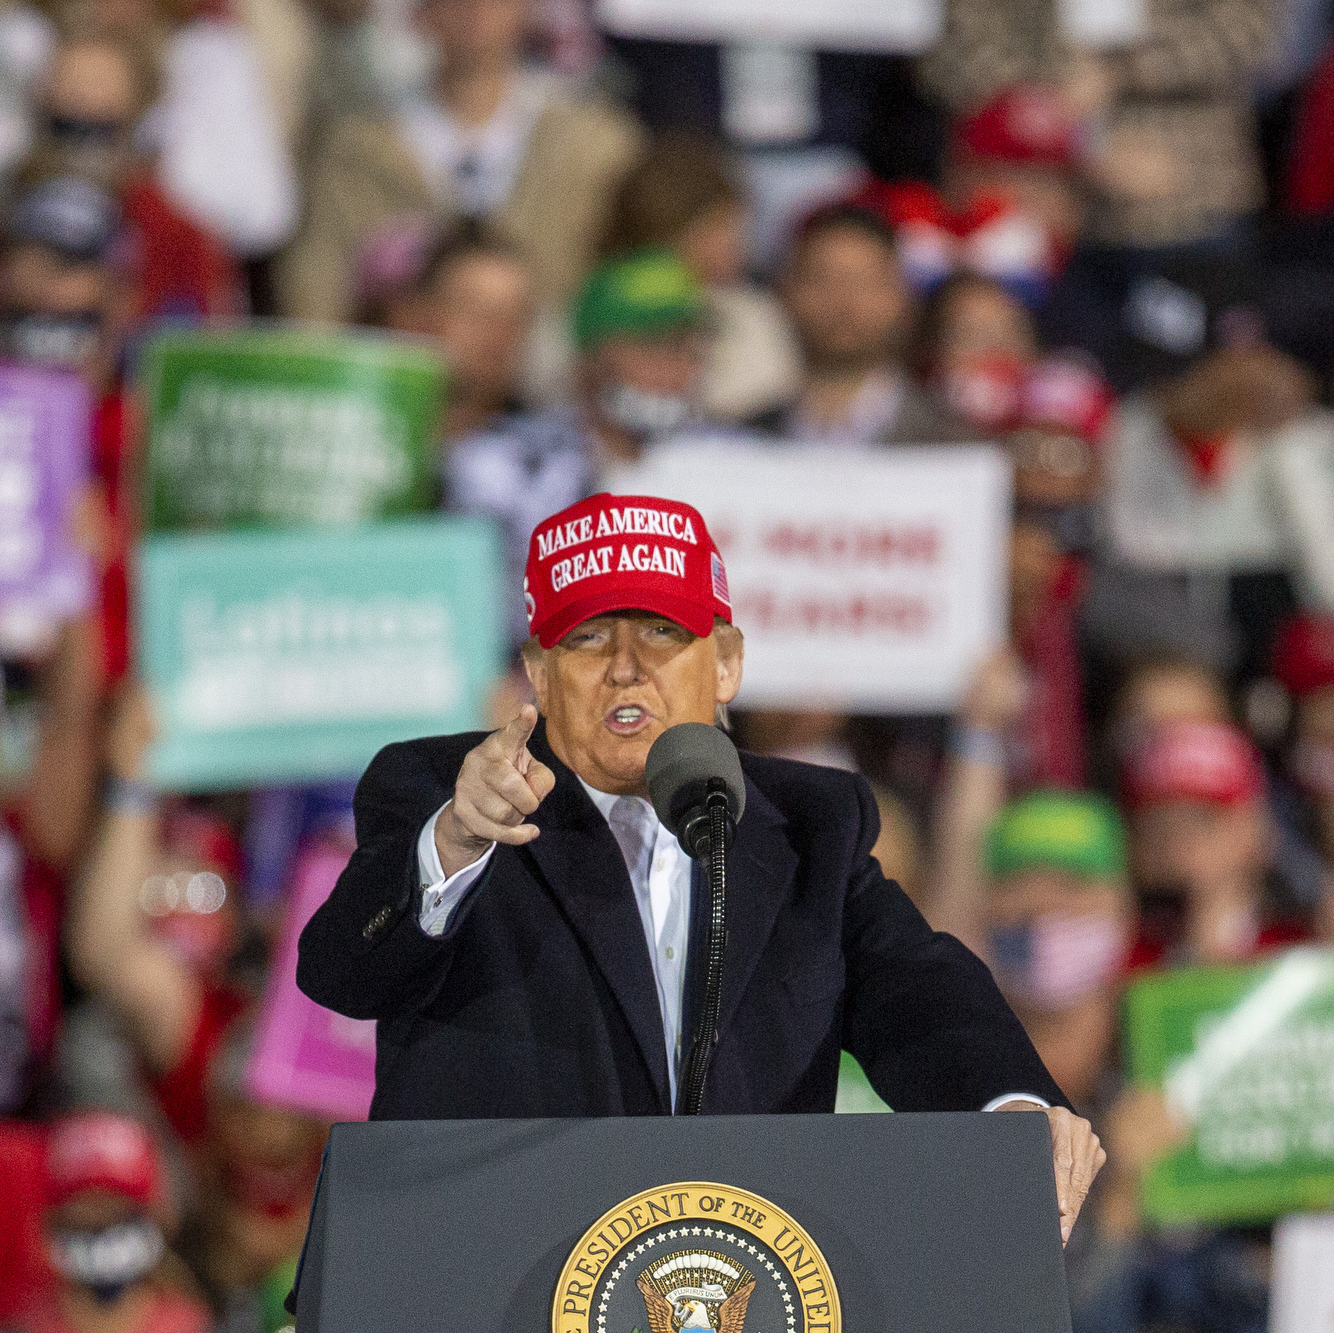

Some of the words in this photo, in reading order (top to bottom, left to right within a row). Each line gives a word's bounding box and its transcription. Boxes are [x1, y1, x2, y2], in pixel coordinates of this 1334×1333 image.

[537, 515, 593, 561] MAKE
[595, 507, 698, 545] AMERICA
[761, 518, 946, 568] MORE
[551, 546, 613, 593] GREAT
[617, 544, 686, 579] AGAIN
[563, 1192, 690, 1317] PRESIDENT
[698, 1196, 726, 1213] OF
[731, 1202, 767, 1229] THE
[674, 1288, 705, 1298] PLURIBUS
[705, 1291, 725, 1299] UNUM
